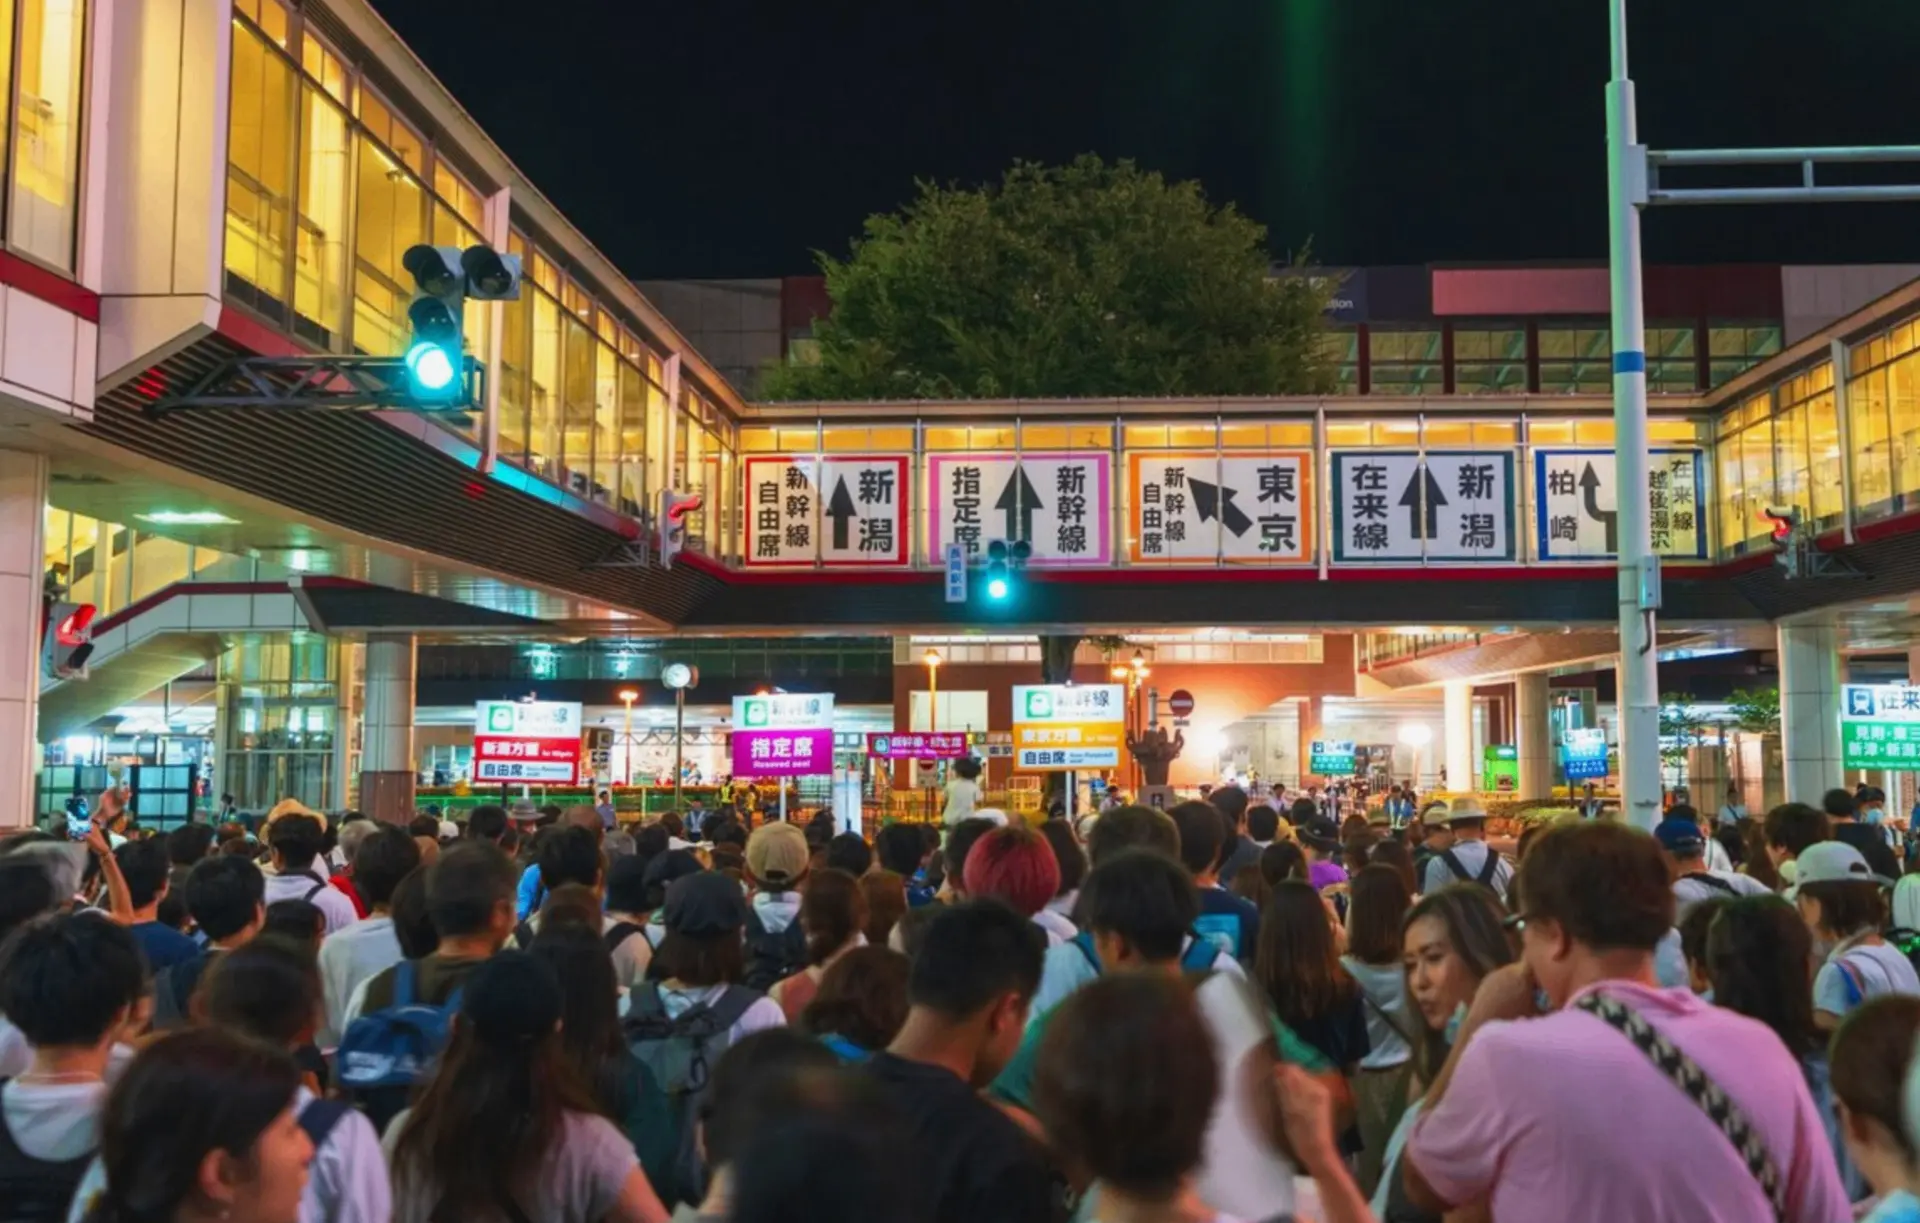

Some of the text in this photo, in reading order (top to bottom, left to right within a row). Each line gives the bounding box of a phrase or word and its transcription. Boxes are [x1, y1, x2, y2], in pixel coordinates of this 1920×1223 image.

[757, 481, 780, 557] 自由席
[785, 465, 810, 548] 新幹線
[858, 468, 894, 553] 新潟
[952, 466, 981, 555] 指定席
[1057, 465, 1086, 553] 新幹線
[1143, 483, 1163, 553] 自由席
[1164, 466, 1186, 542] 新幹線
[1256, 465, 1296, 552] 東京
[1352, 463, 1389, 550] 在来線
[1458, 463, 1495, 549] 新潟
[1548, 469, 1577, 542] 柏崎
[1648, 470, 1670, 548] 越後湯沢
[1671, 459, 1694, 531] 在来線
[483, 763, 523, 777] 自由席
[750, 737, 813, 759] 指定席
[1024, 751, 1066, 765] 自由席
